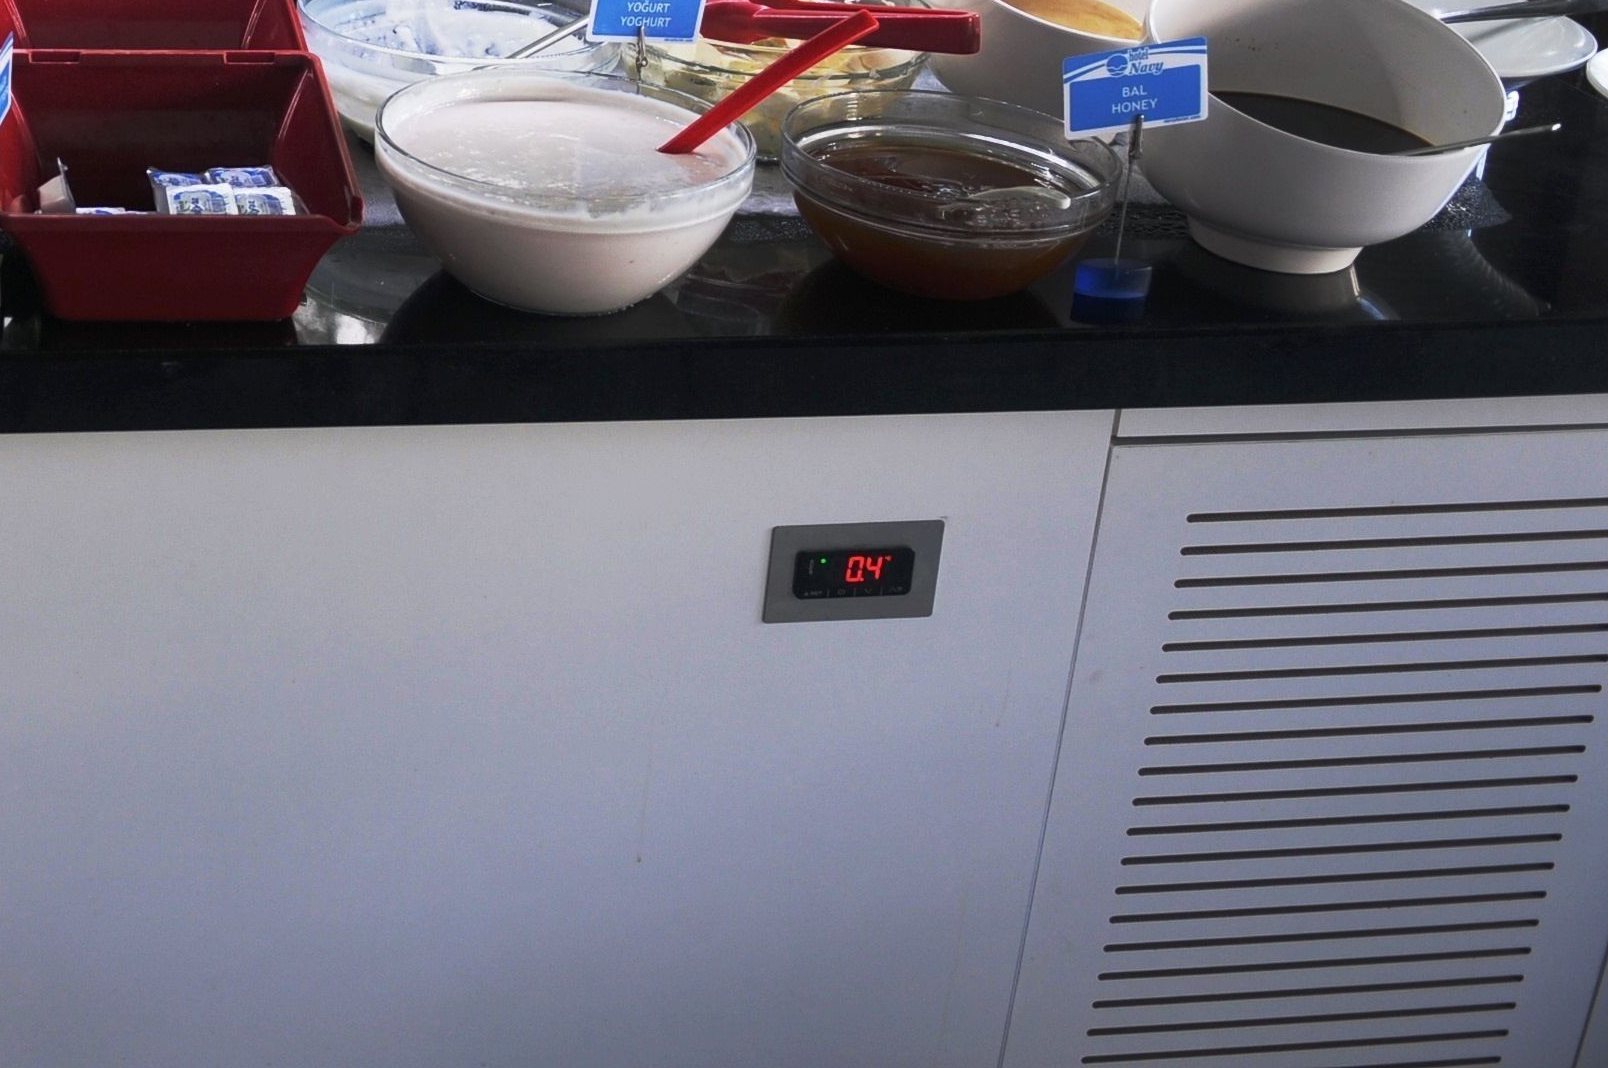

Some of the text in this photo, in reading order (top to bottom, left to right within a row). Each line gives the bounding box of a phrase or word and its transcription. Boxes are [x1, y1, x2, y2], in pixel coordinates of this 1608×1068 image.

[627, 0, 671, 13] YOĞURT
[620, 16, 672, 28] YOGHURT
[1128, 47, 1149, 61] hotel
[1128, 61, 1164, 76] Navy
[1121, 85, 1148, 98] BAL
[1111, 98, 1158, 114] HONEY
